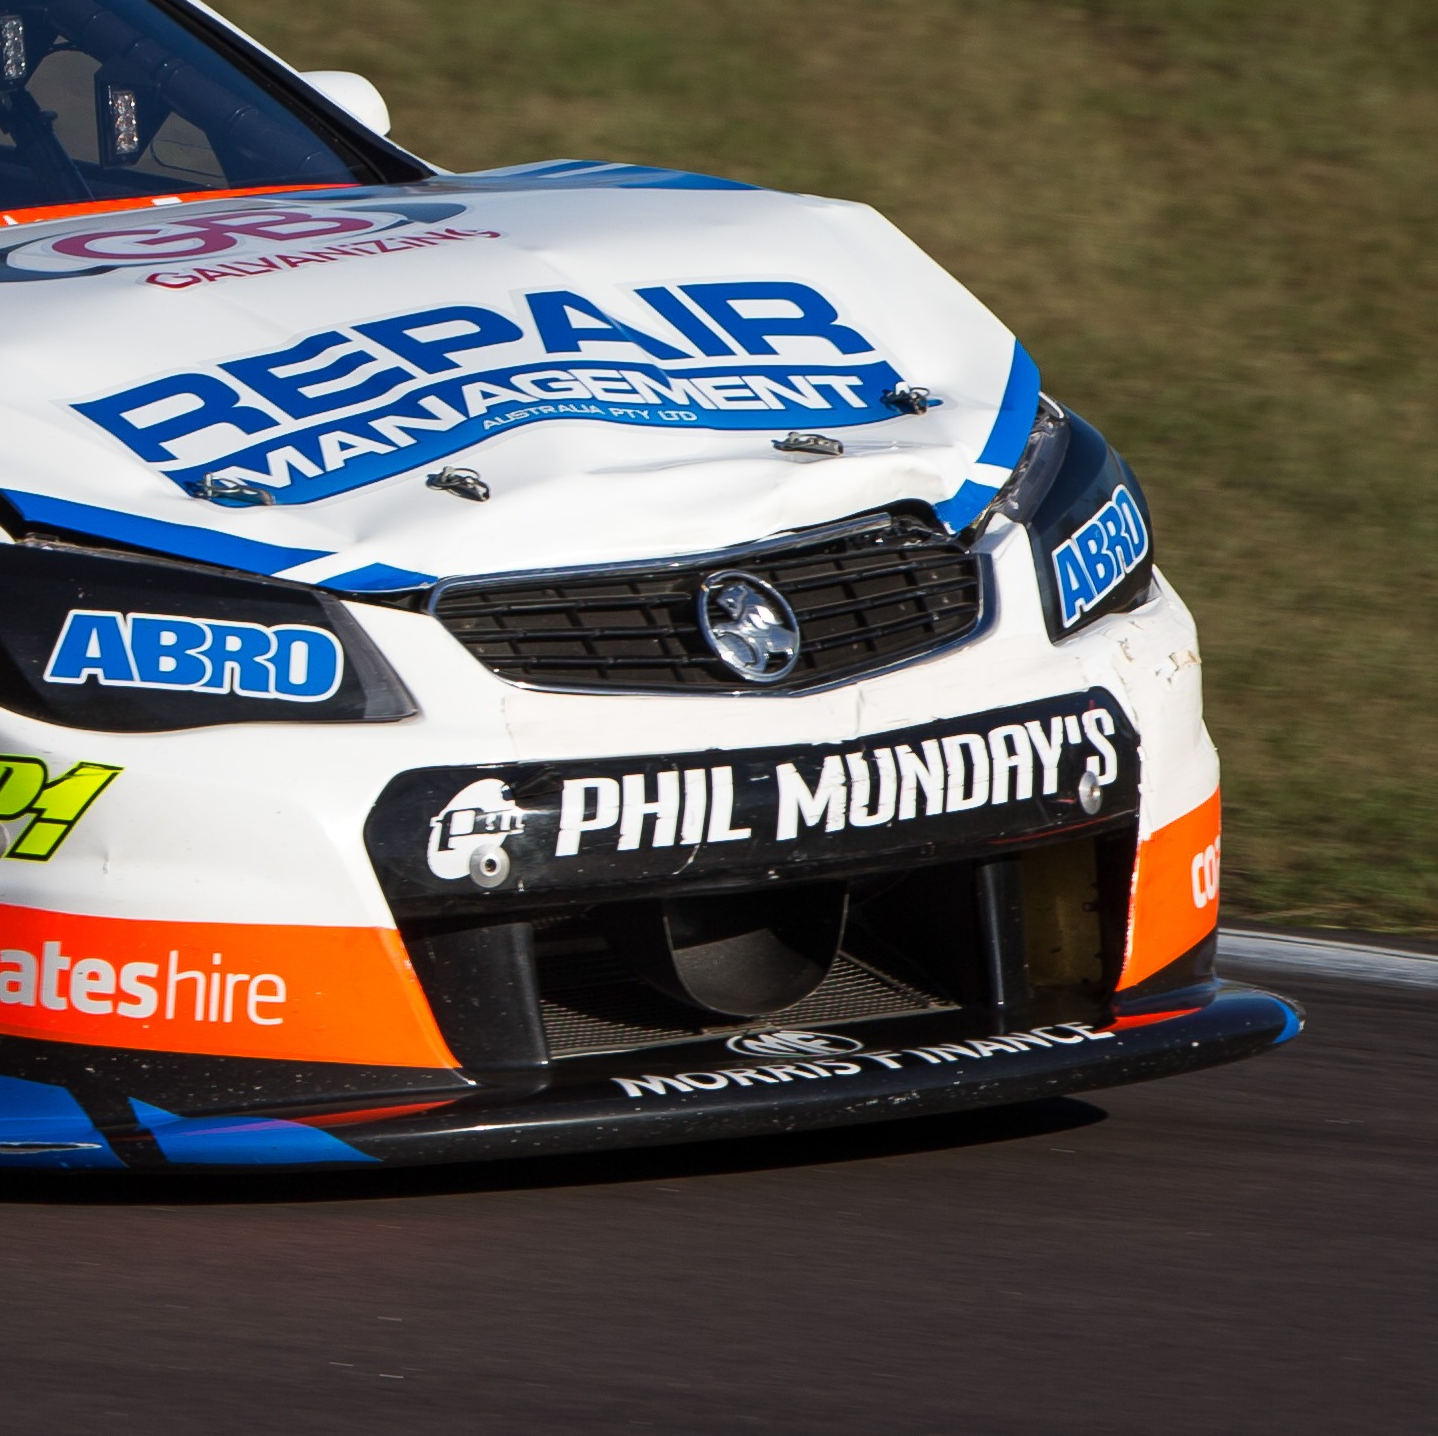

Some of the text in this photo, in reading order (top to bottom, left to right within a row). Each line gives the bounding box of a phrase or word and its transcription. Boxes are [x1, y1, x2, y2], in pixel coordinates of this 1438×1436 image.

[68, 280, 875, 463] REPAIR
[211, 368, 869, 490] MANAGEMENT
[483, 404, 698, 430] AUSTRALIA PTY LTD
[1052, 484, 1149, 628] ABRO
[44, 609, 344, 703] ABRO
[555, 707, 1119, 856] PHIL MUNDAY'S
[611, 1021, 1116, 1098] MORRIS FINANCE
